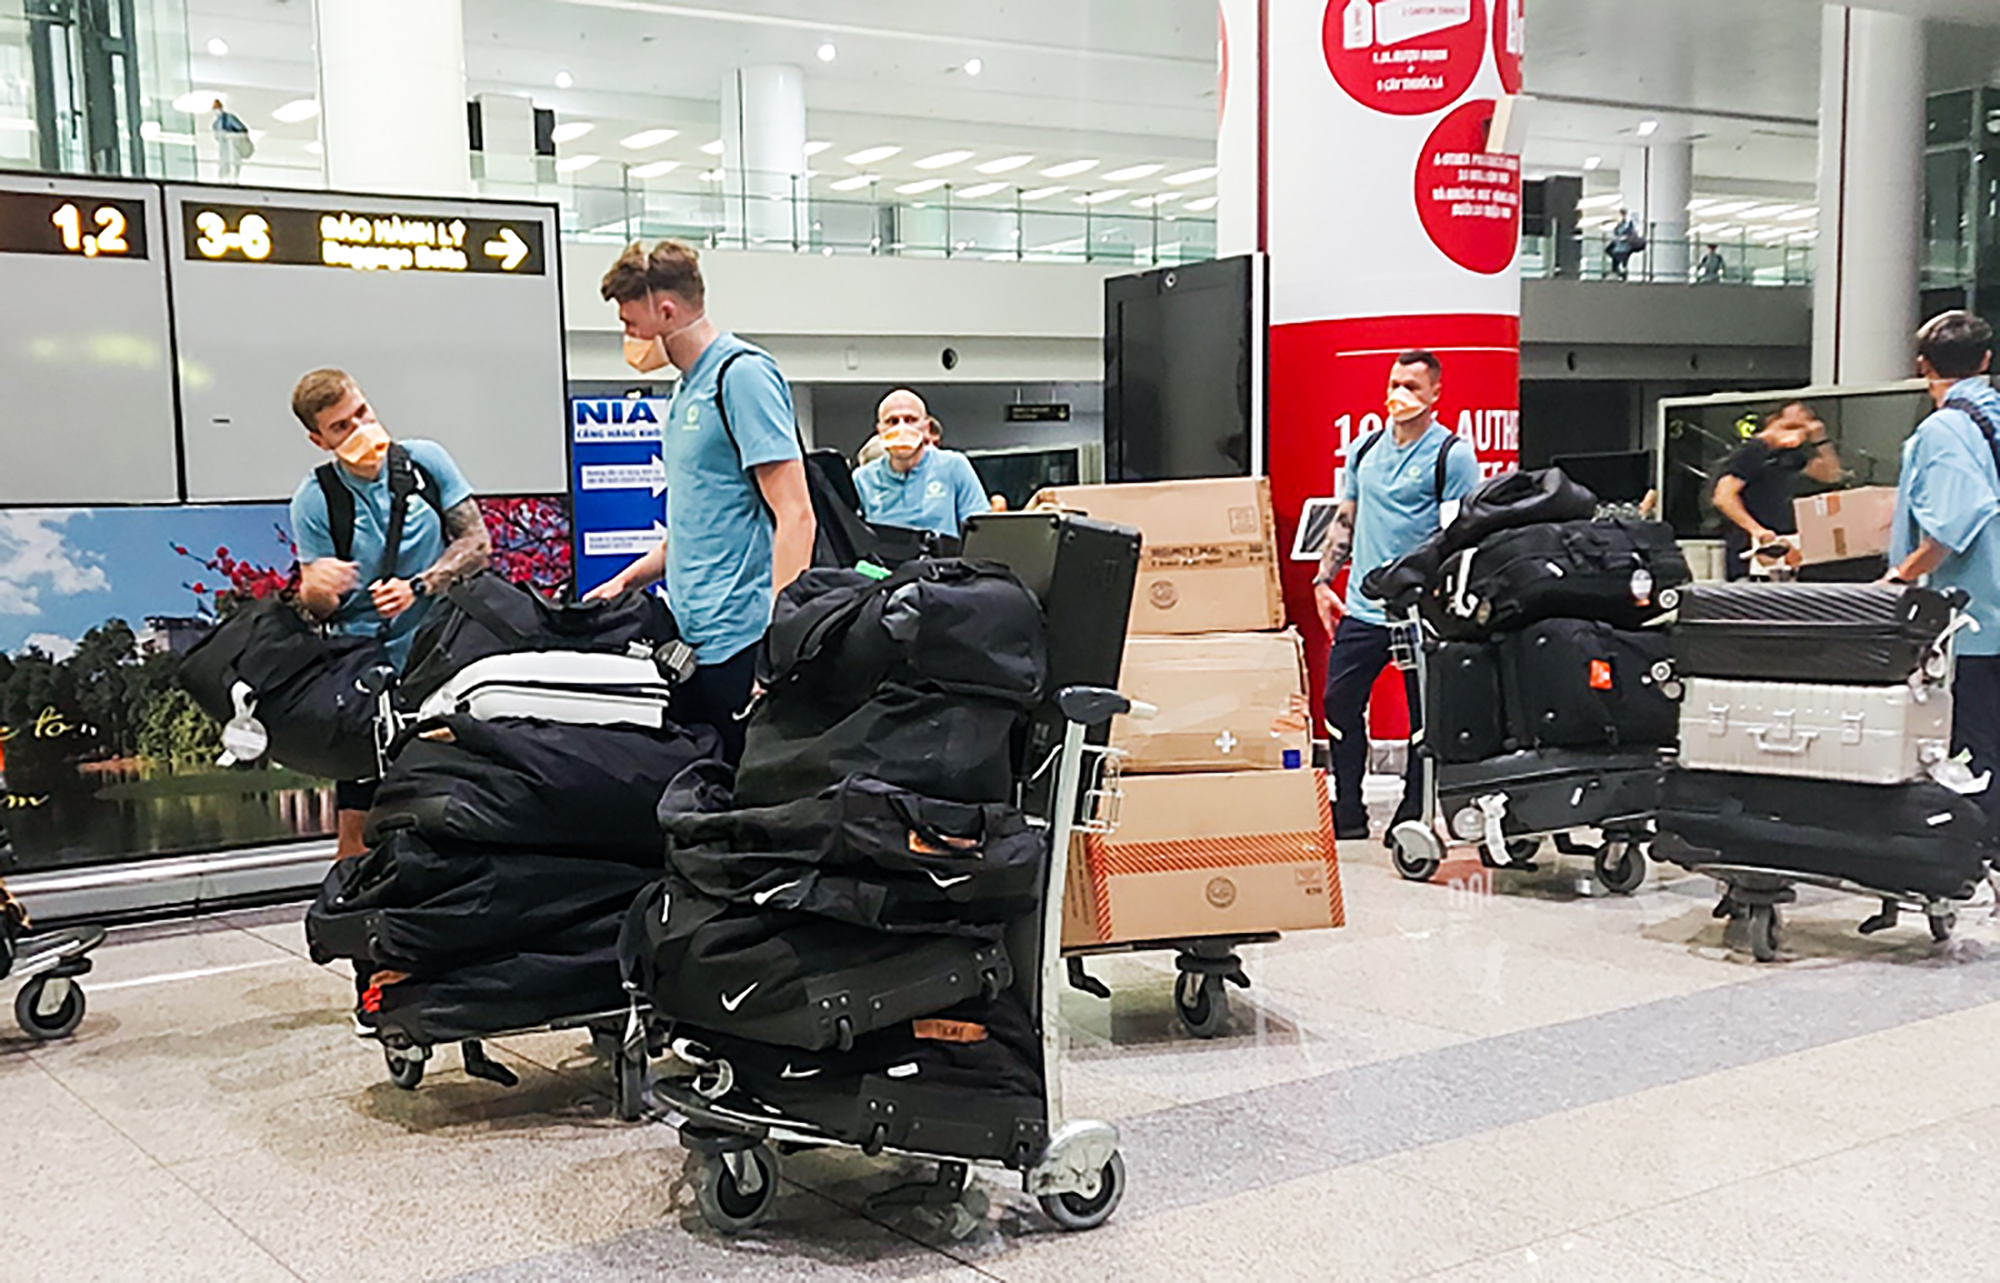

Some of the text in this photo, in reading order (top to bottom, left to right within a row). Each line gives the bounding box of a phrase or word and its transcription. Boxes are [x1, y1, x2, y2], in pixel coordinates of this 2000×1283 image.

[52, 203, 128, 256] 1,2
[196, 211, 271, 260] 3-6
[576, 401, 659, 424] NIA
